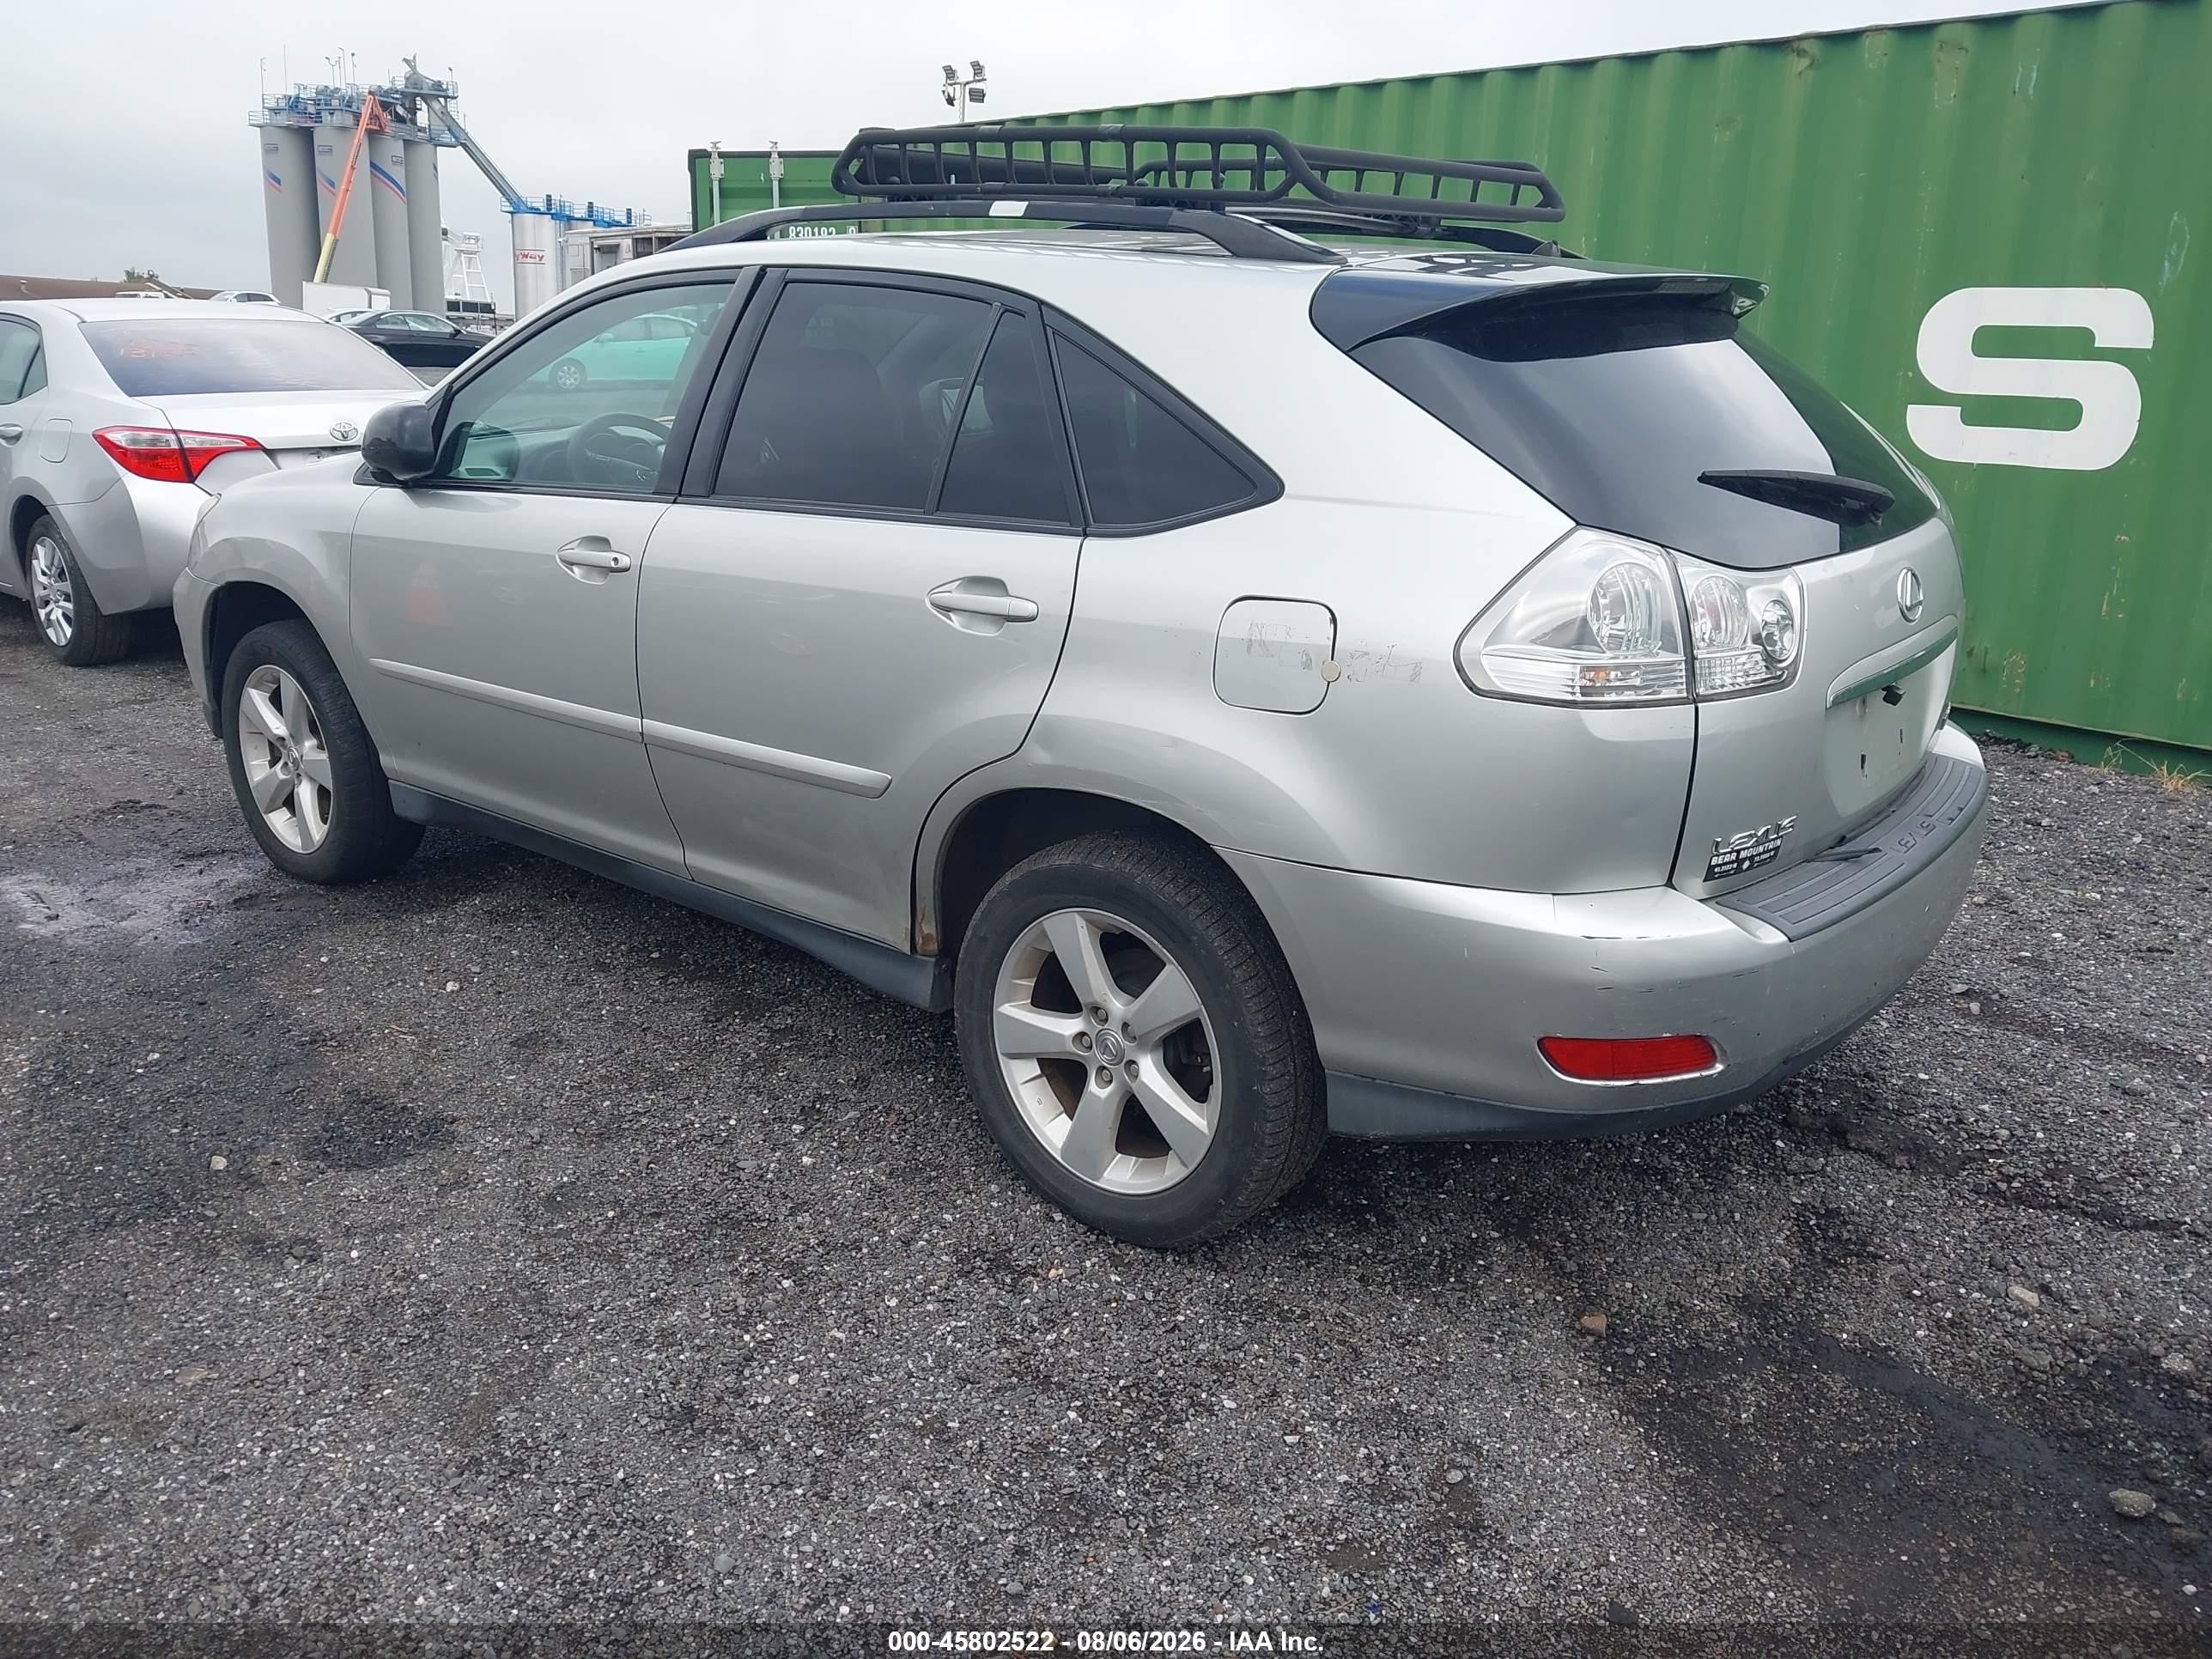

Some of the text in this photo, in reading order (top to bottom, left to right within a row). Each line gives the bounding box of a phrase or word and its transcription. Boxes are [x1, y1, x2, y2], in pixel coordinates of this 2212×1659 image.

[1906, 287, 2154, 471] S
[1711, 853, 1737, 866] BEAR
[1739, 838, 1783, 860] MOUNTAIN
[1712, 815, 1797, 854] LEXUS
